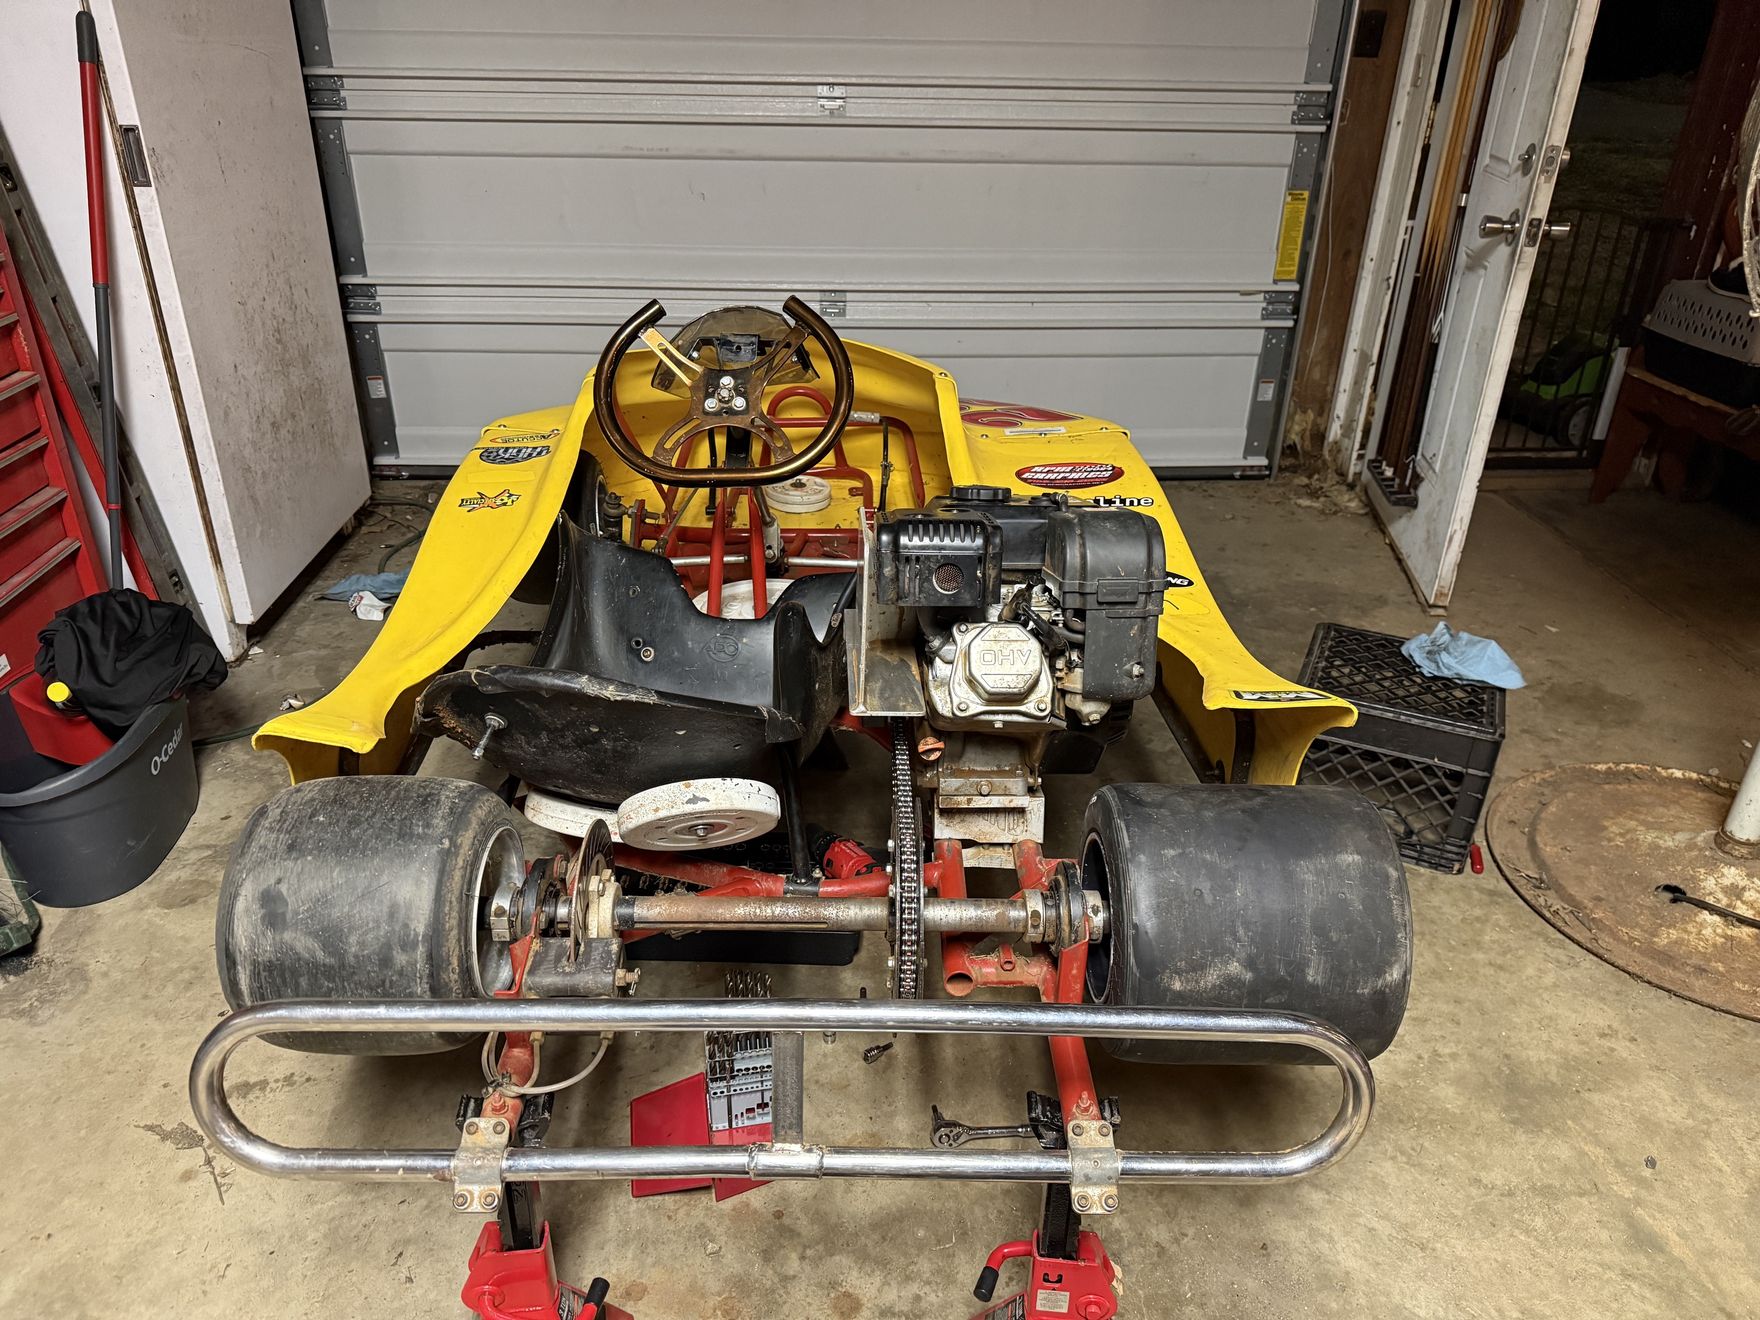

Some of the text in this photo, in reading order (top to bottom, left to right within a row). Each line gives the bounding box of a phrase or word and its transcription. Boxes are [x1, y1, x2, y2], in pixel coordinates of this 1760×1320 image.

[1087, 495, 1154, 507] line
[980, 649, 1032, 666] OHV
[150, 722, 183, 776] O-Cedar
